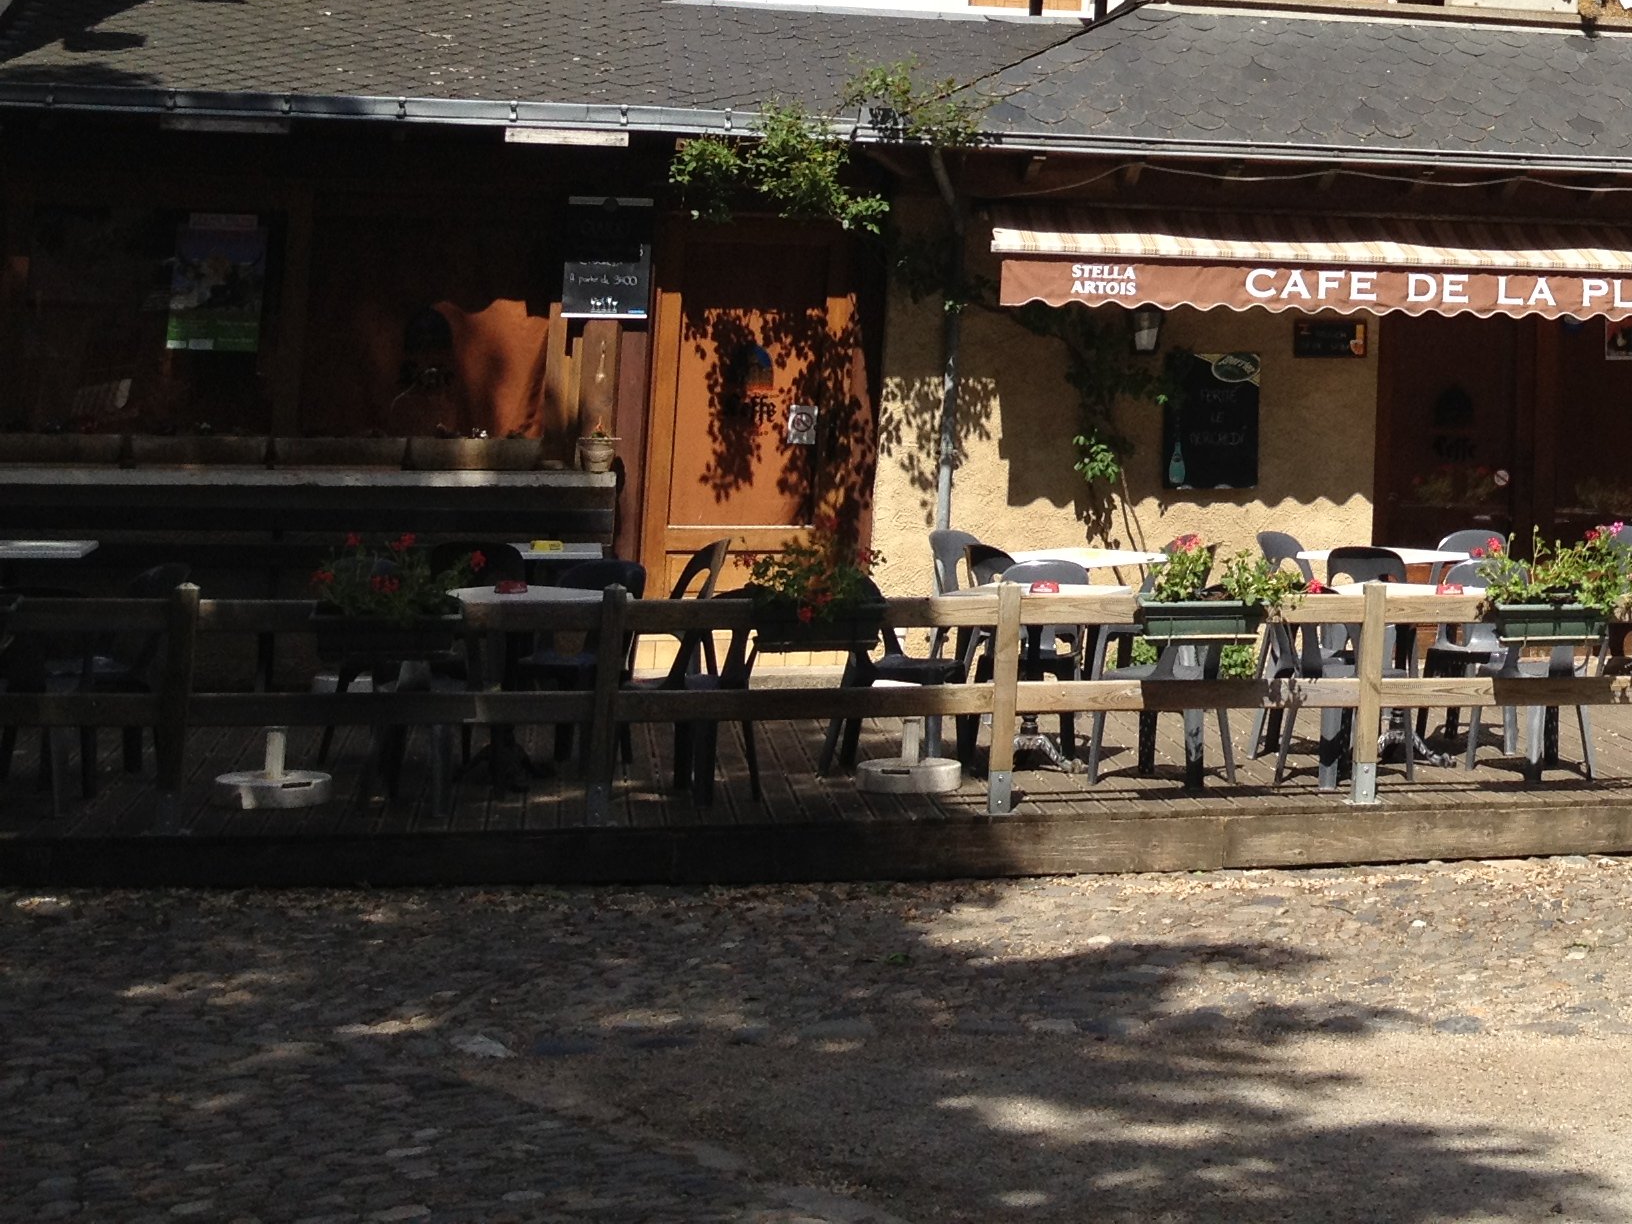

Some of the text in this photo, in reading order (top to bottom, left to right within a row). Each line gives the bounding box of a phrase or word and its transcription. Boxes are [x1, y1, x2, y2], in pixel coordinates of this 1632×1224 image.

[1072, 264, 1136, 279] STELLA
[1070, 280, 1136, 295] ARTOIS
[1245, 268, 1377, 301] CAFE
[1407, 273, 1469, 303] DE
[1497, 276, 1557, 306] LA
